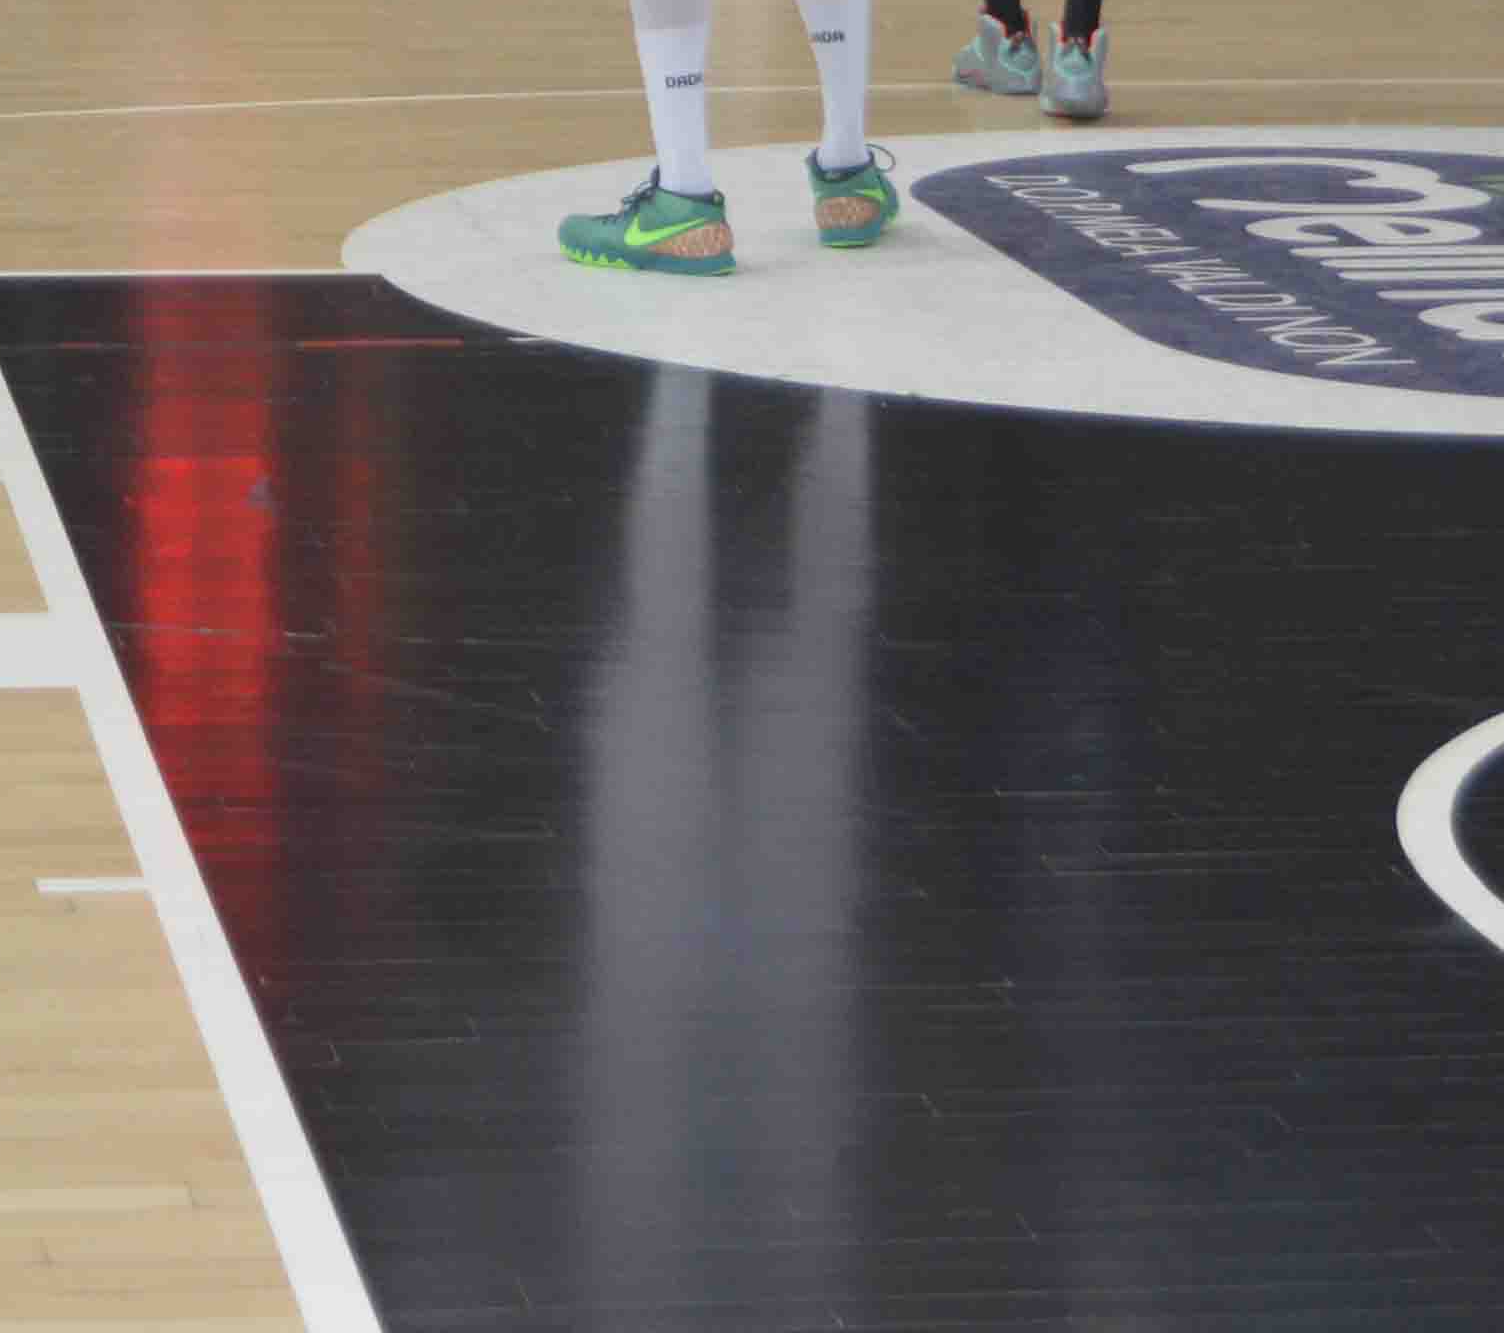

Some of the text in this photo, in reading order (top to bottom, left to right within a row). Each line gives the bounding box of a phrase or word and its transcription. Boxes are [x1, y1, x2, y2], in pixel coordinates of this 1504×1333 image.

[1052, 213, 1201, 257] MELA
[1141, 257, 1265, 291] VAL
[1197, 293, 1313, 315] DI
[1235, 315, 1417, 366] NON
